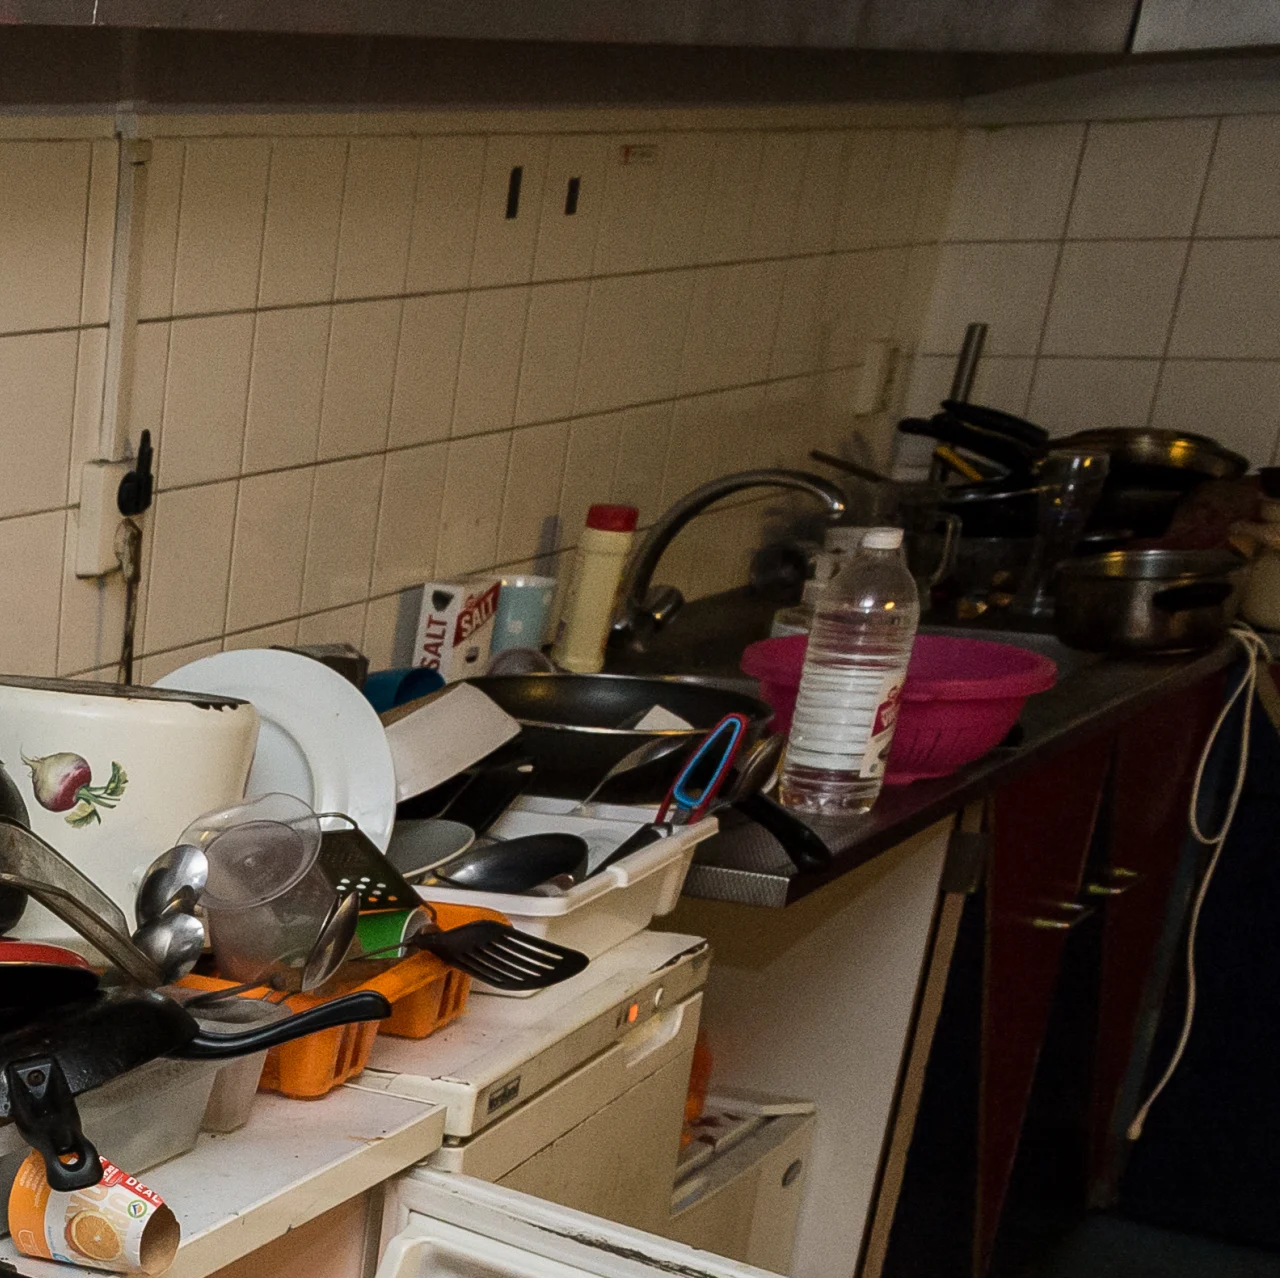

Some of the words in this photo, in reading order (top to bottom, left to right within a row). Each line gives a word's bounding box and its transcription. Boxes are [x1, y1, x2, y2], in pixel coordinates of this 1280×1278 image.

[461, 591, 495, 639] SALT
[420, 613, 448, 673] SALT
[124, 1176, 160, 1203] DEAL
